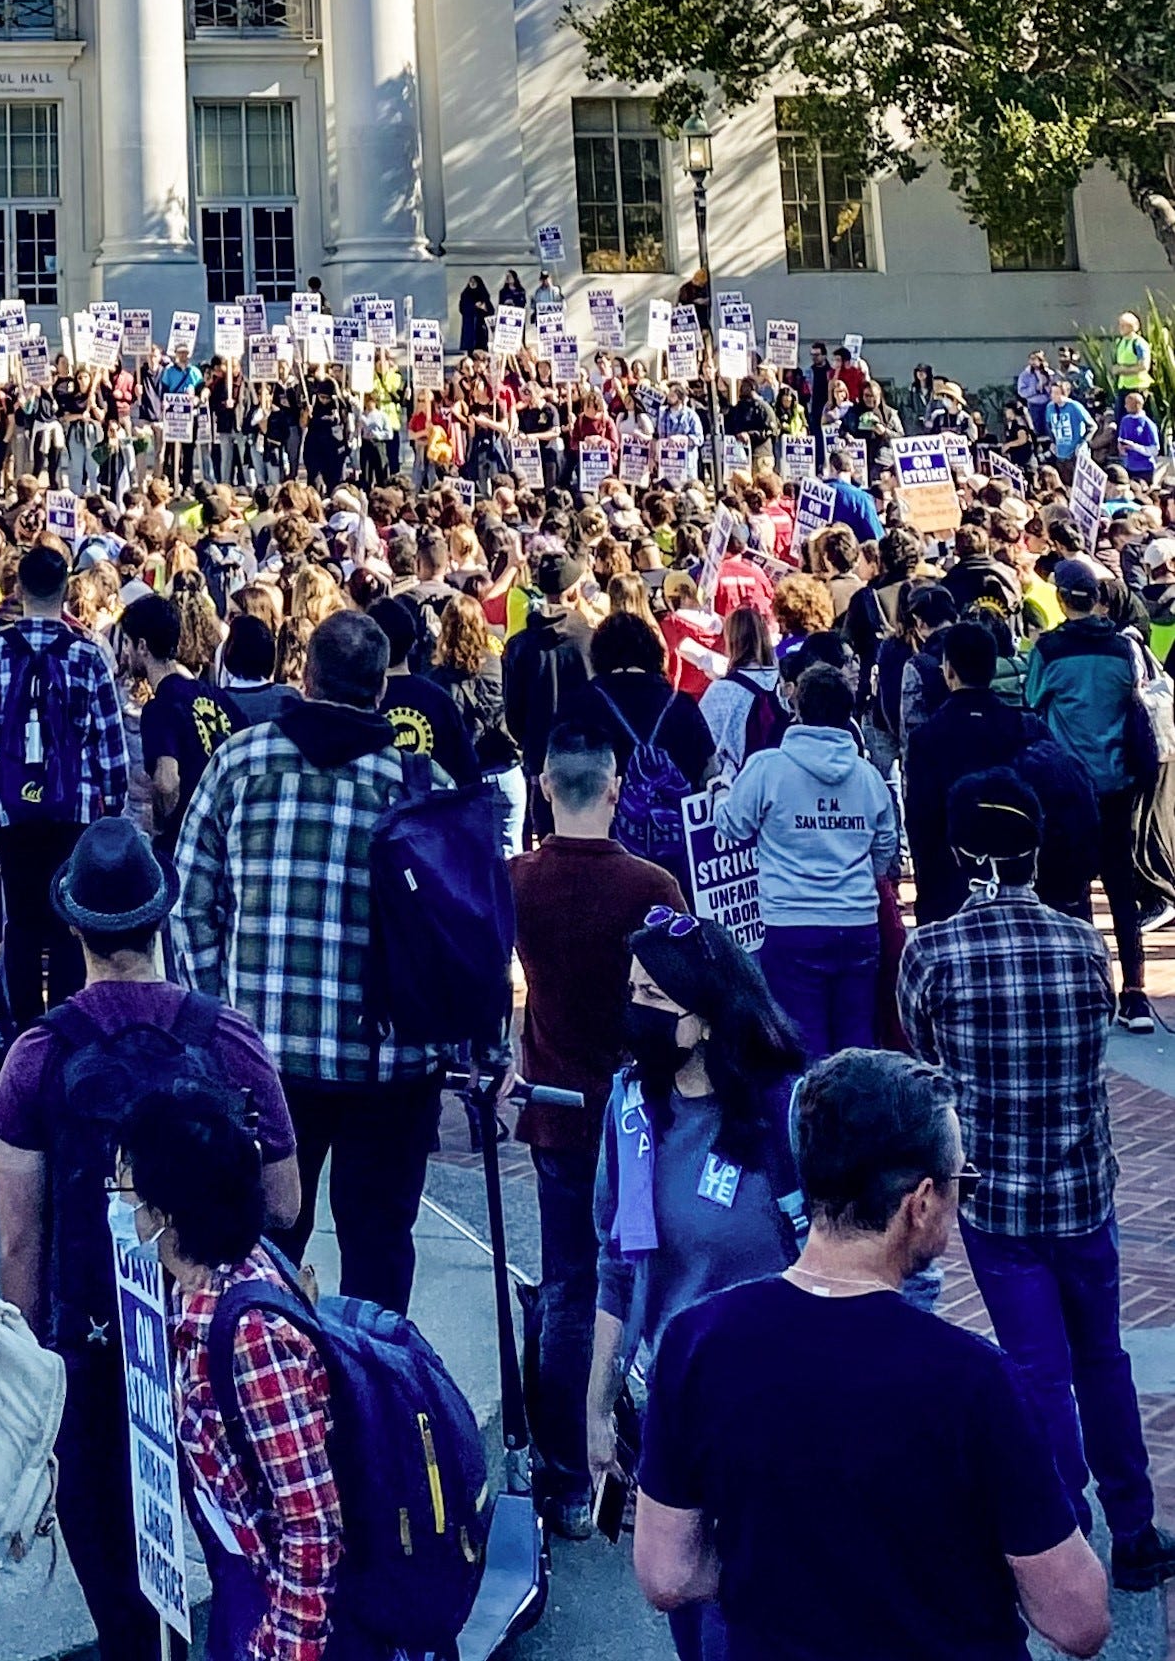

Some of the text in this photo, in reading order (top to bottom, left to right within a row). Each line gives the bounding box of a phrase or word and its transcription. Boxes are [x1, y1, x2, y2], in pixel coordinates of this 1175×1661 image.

[21, 74, 53, 83] HALL
[98, 322, 121, 332] UAW
[640, 385, 664, 400] UAW
[624, 436, 649, 445] UAW
[896, 440, 940, 453] UAW
[912, 455, 932, 469] ON
[992, 455, 1020, 477] UAW
[1079, 455, 1104, 486] UAW
[903, 468, 949, 483] STRIKE
[51, 493, 75, 509] UAW
[803, 481, 832, 502] UAW
[808, 501, 822, 514] ON
[21, 781, 44, 803] Cal
[795, 815, 816, 829] SAN
[697, 847, 759, 885] STRIKE
[708, 880, 759, 910] UNFAIR
[734, 921, 765, 945] CTIC
[708, 1158, 736, 1184] UP
[705, 1175, 732, 1202] TE
[135, 1313, 155, 1366] ON
[129, 1363, 173, 1445] STRIKE
[141, 1493, 175, 1556] LABOR
[139, 1532, 187, 1618] PRACTICE
